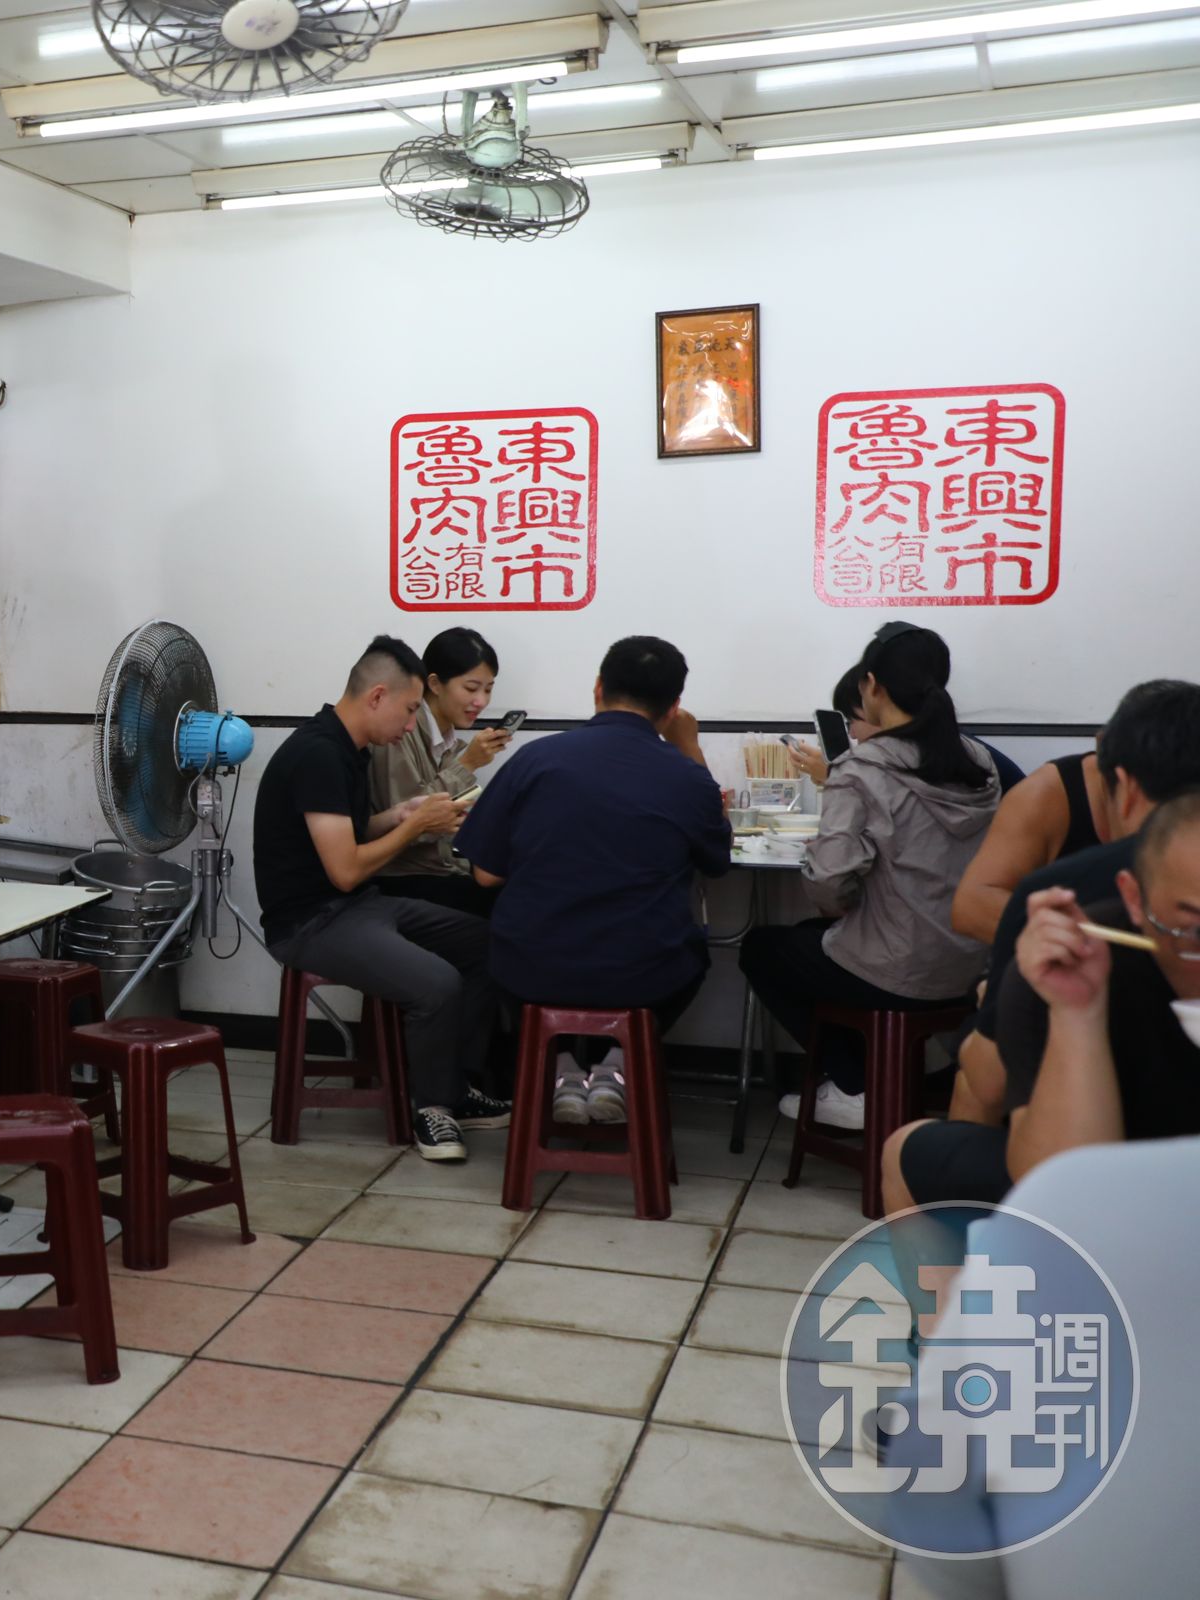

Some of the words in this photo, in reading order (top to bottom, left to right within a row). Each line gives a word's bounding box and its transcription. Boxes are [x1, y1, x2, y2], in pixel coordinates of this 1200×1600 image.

[490, 421, 587, 603] 東興市
[934, 398, 1050, 605] 東興市
